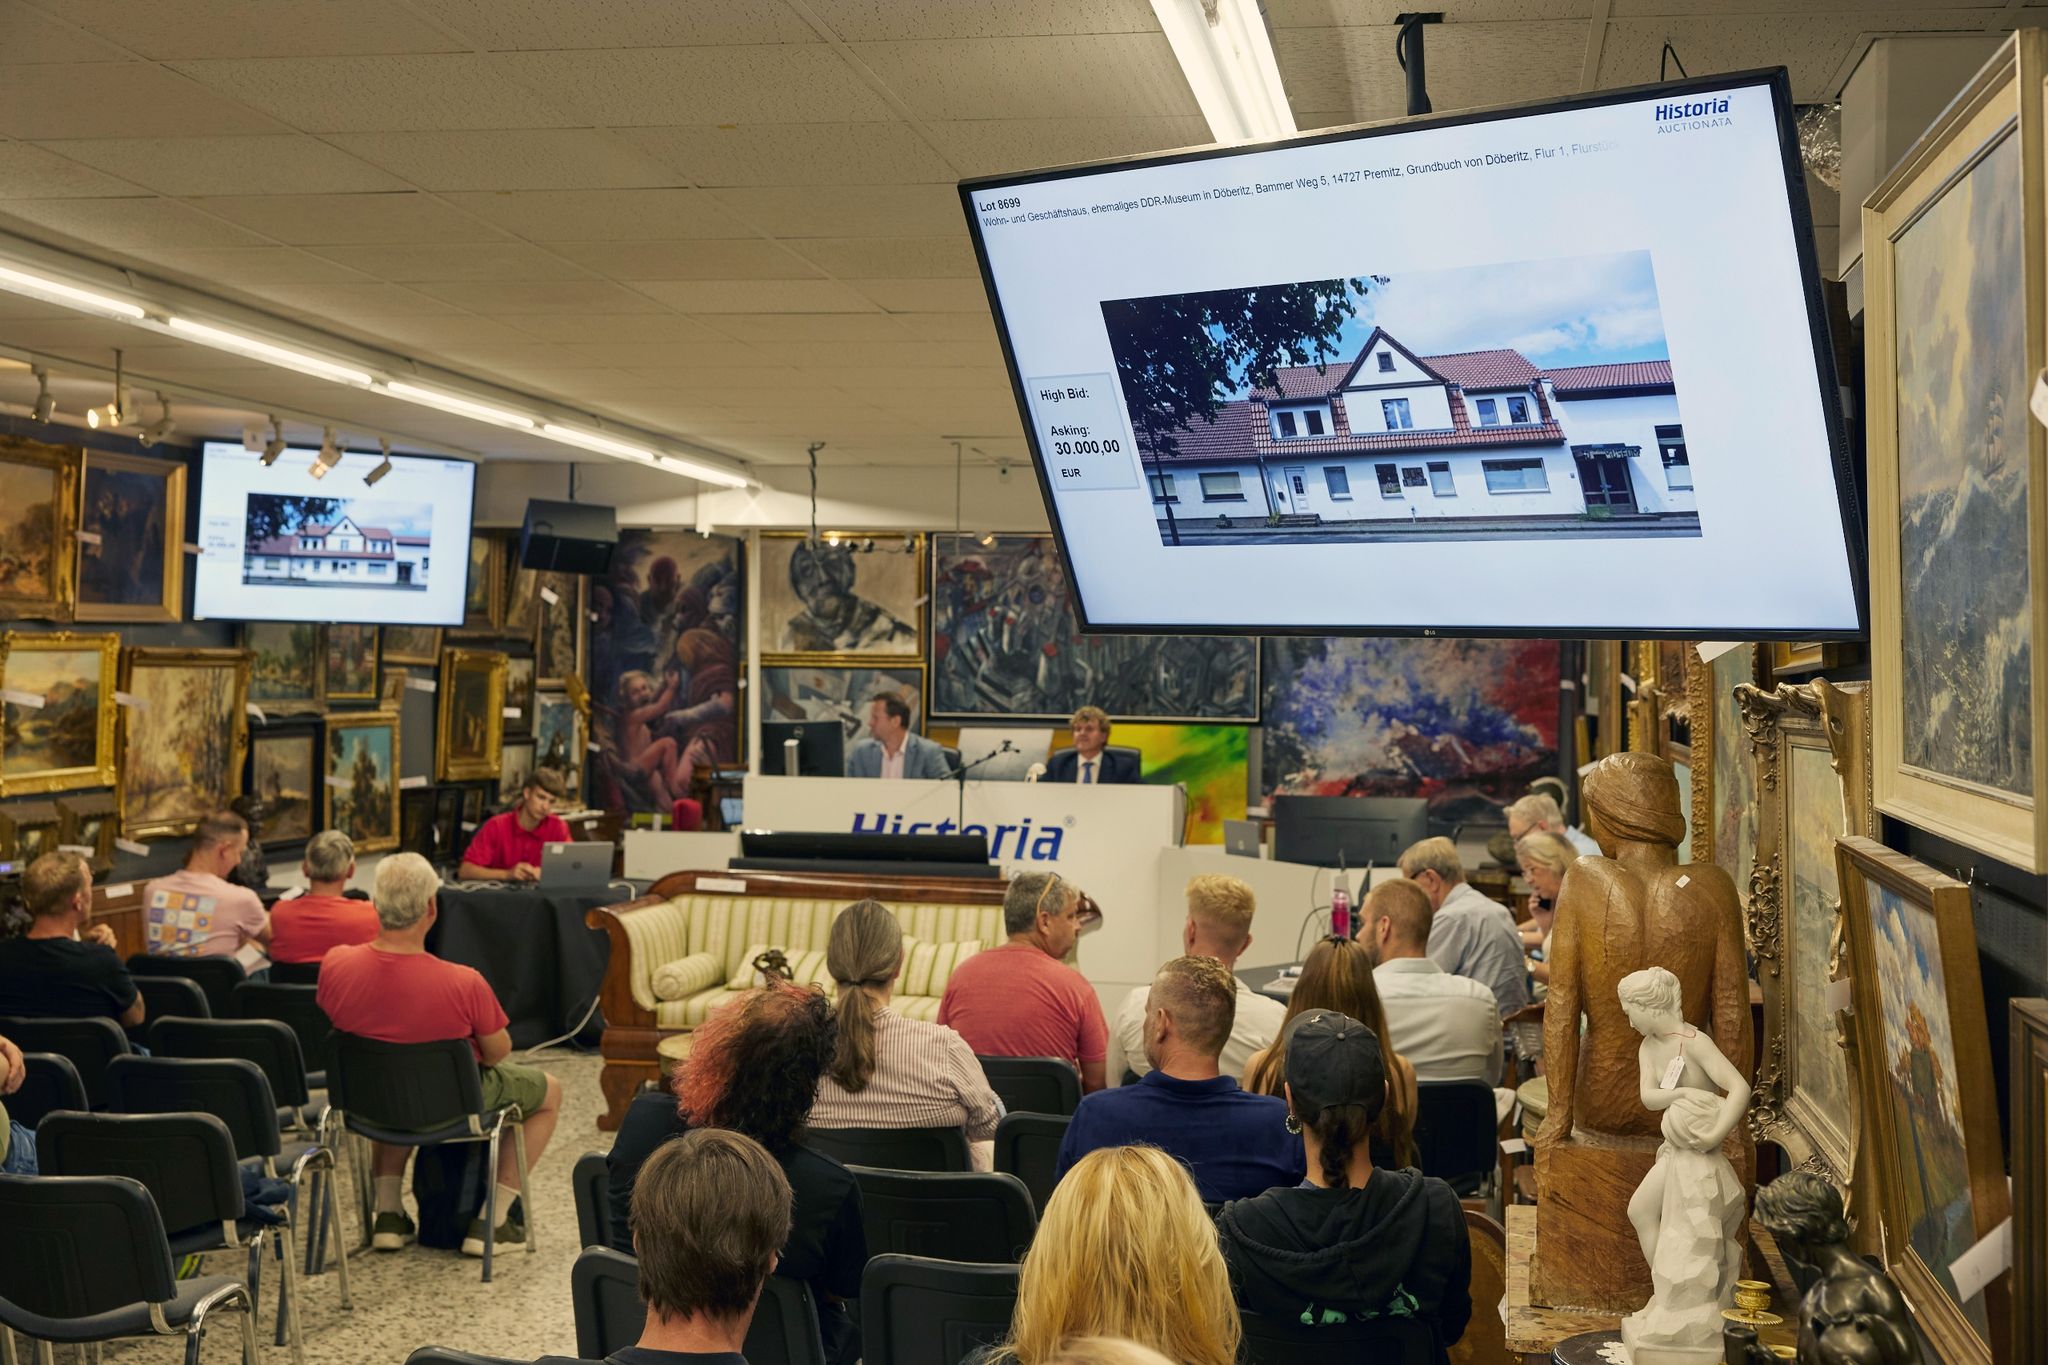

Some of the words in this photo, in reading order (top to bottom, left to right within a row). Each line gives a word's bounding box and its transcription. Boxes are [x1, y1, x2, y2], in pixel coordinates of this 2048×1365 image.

[1655, 98, 1729, 121] Historia
[1657, 117, 1733, 134] AUCTIONATA
[983, 214, 1010, 227] Wohn-
[1011, 213, 1026, 224] und
[1027, 205, 1090, 222] Geschäftshaus,
[1091, 199, 1139, 215] ehemaliges
[1140, 190, 1202, 208] DDR-Museum
[1202, 189, 1212, 201] in
[1213, 183, 1254, 200] Döberitz,
[1256, 179, 1294, 195] Bammer
[1295, 176, 1319, 190] Weg
[1320, 175, 1330, 188] 5,
[1332, 171, 1361, 185] 14727
[1363, 165, 1404, 182] Premitz,
[1406, 157, 1462, 176] Grundbuch
[1464, 156, 1483, 168] von
[1485, 149, 1532, 167] Döberitz,
[1534, 146, 1556, 160] Flur
[1558, 145, 1569, 158] 1,
[979, 200, 997, 212] Lot
[998, 197, 1021, 210] 8699
[1040, 389, 1065, 403] High
[1067, 387, 1090, 399] Bid:
[1051, 425, 1091, 438] Asking:
[1055, 439, 1120, 456] 30.000,00
[1061, 468, 1081, 478] EUR
